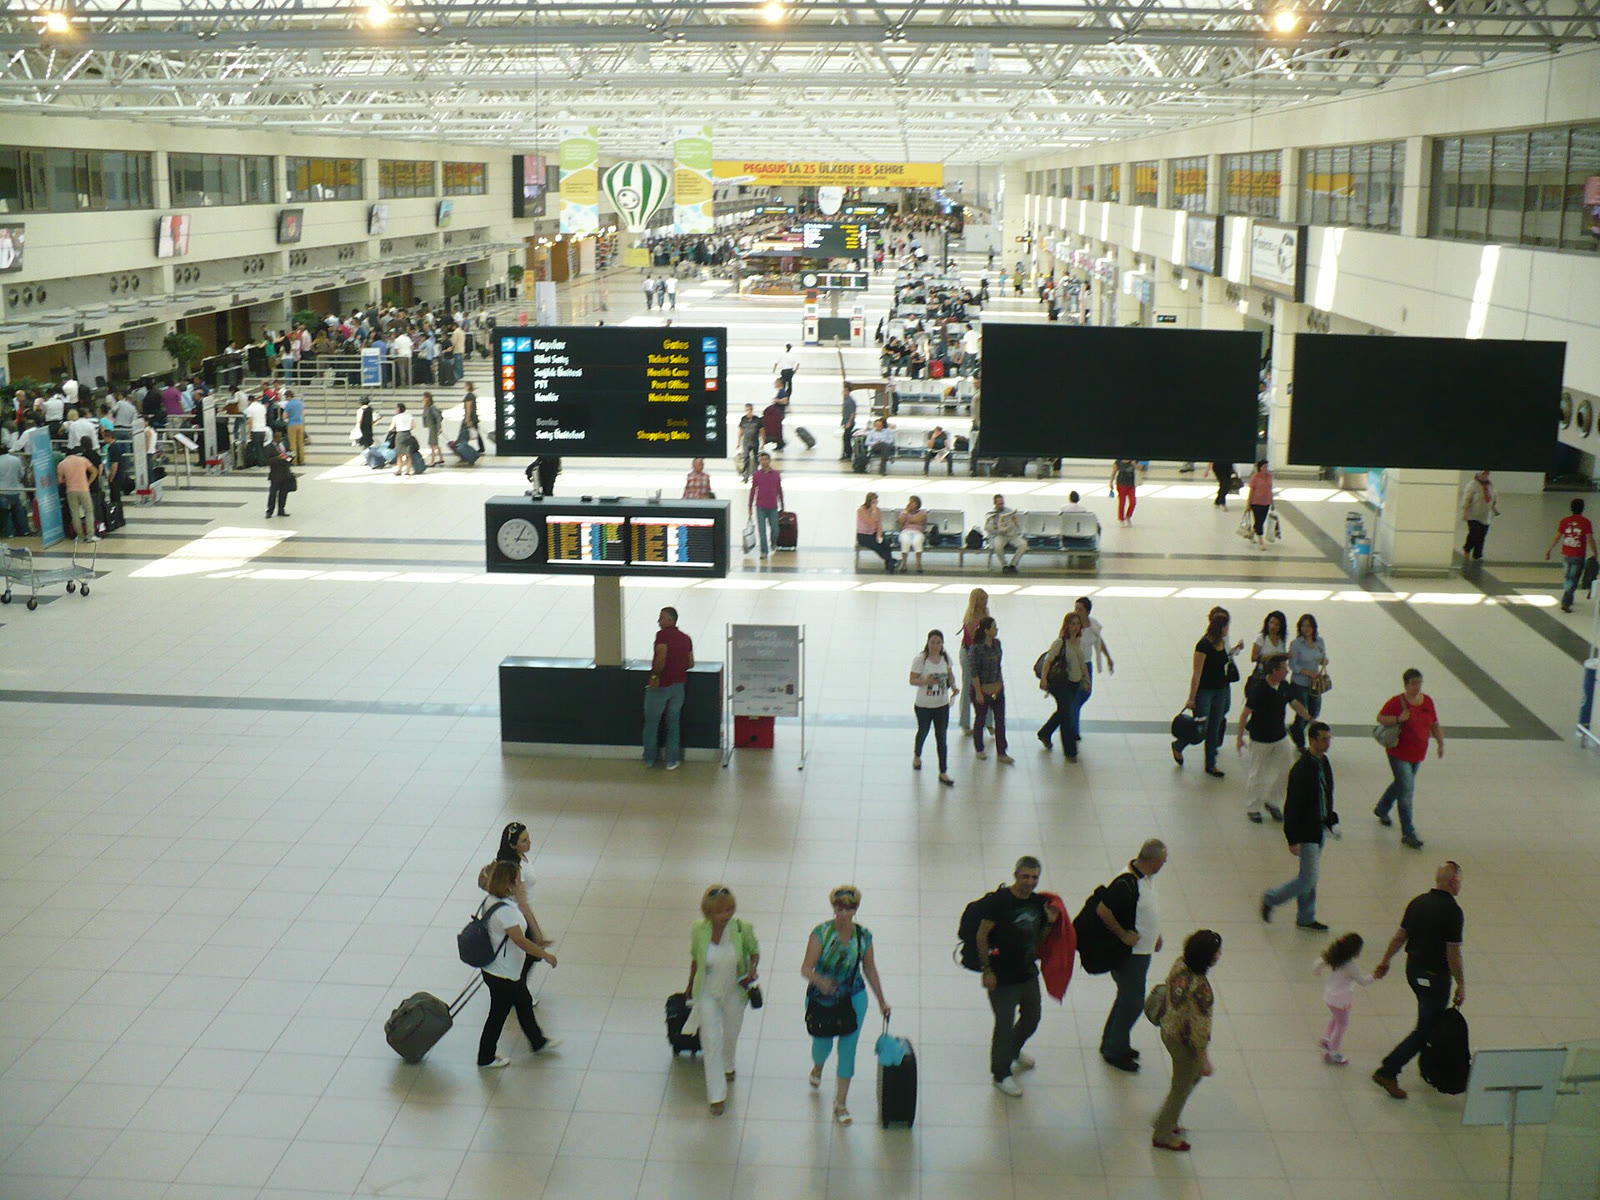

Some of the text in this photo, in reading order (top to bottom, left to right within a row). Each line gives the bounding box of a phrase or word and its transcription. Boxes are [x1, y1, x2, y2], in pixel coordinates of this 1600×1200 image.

[803, 164, 816, 174] 25
[819, 163, 855, 174] ÜLKEDE
[873, 164, 905, 175] ŞEHRE
[533, 338, 567, 352] Kapılar
[663, 338, 689, 350] Gates
[647, 354, 689, 364] Ticket Sales
[647, 367, 689, 377] Health Care
[534, 379, 549, 389] PTT
[651, 379, 689, 389] Post Office
[636, 429, 691, 442] Shopping Units
